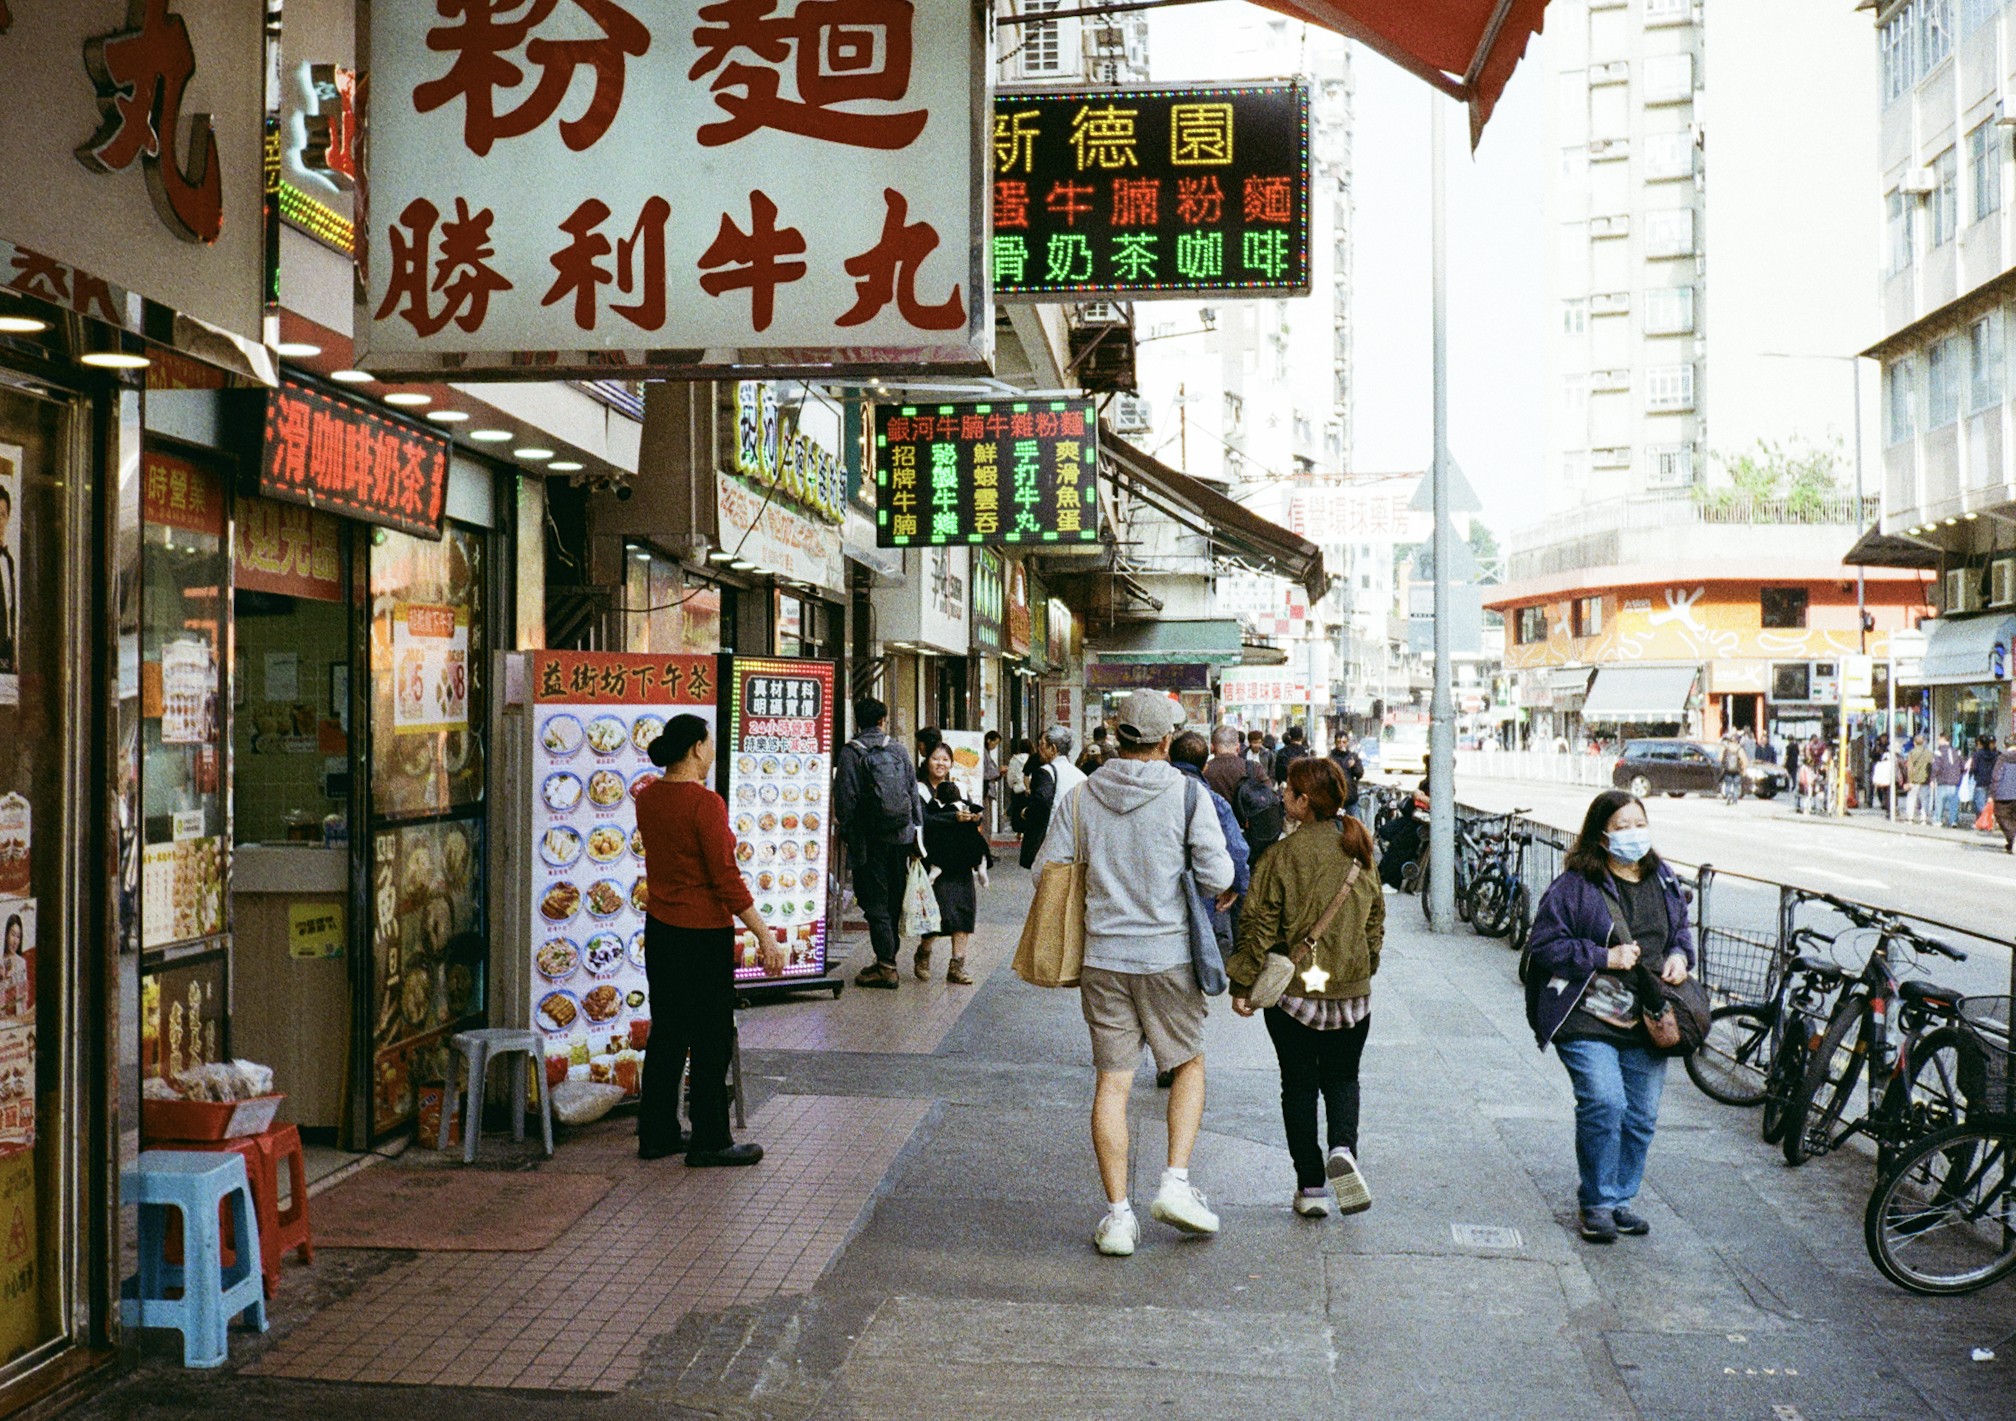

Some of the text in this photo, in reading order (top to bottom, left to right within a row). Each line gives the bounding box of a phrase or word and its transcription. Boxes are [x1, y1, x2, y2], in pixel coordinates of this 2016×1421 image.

[993, 103, 1234, 173] 新德園
[374, 188, 967, 338] 勝利牛丸
[887, 410, 1085, 442] 銀河牛腩牛雜粉麵
[891, 445, 917, 536] 招牌牛腩
[973, 442, 999, 533] 鮮蝦雲吞
[1013, 440, 1041, 532] 手打牛丸
[1055, 440, 1081, 532] 爽滑魚蛋
[539, 659, 713, 700] 益街坊下午茶
[753, 679, 815, 699] 真材實料
[753, 698, 815, 717] 明碼實價
[748, 719, 816, 737] 24小時營業
